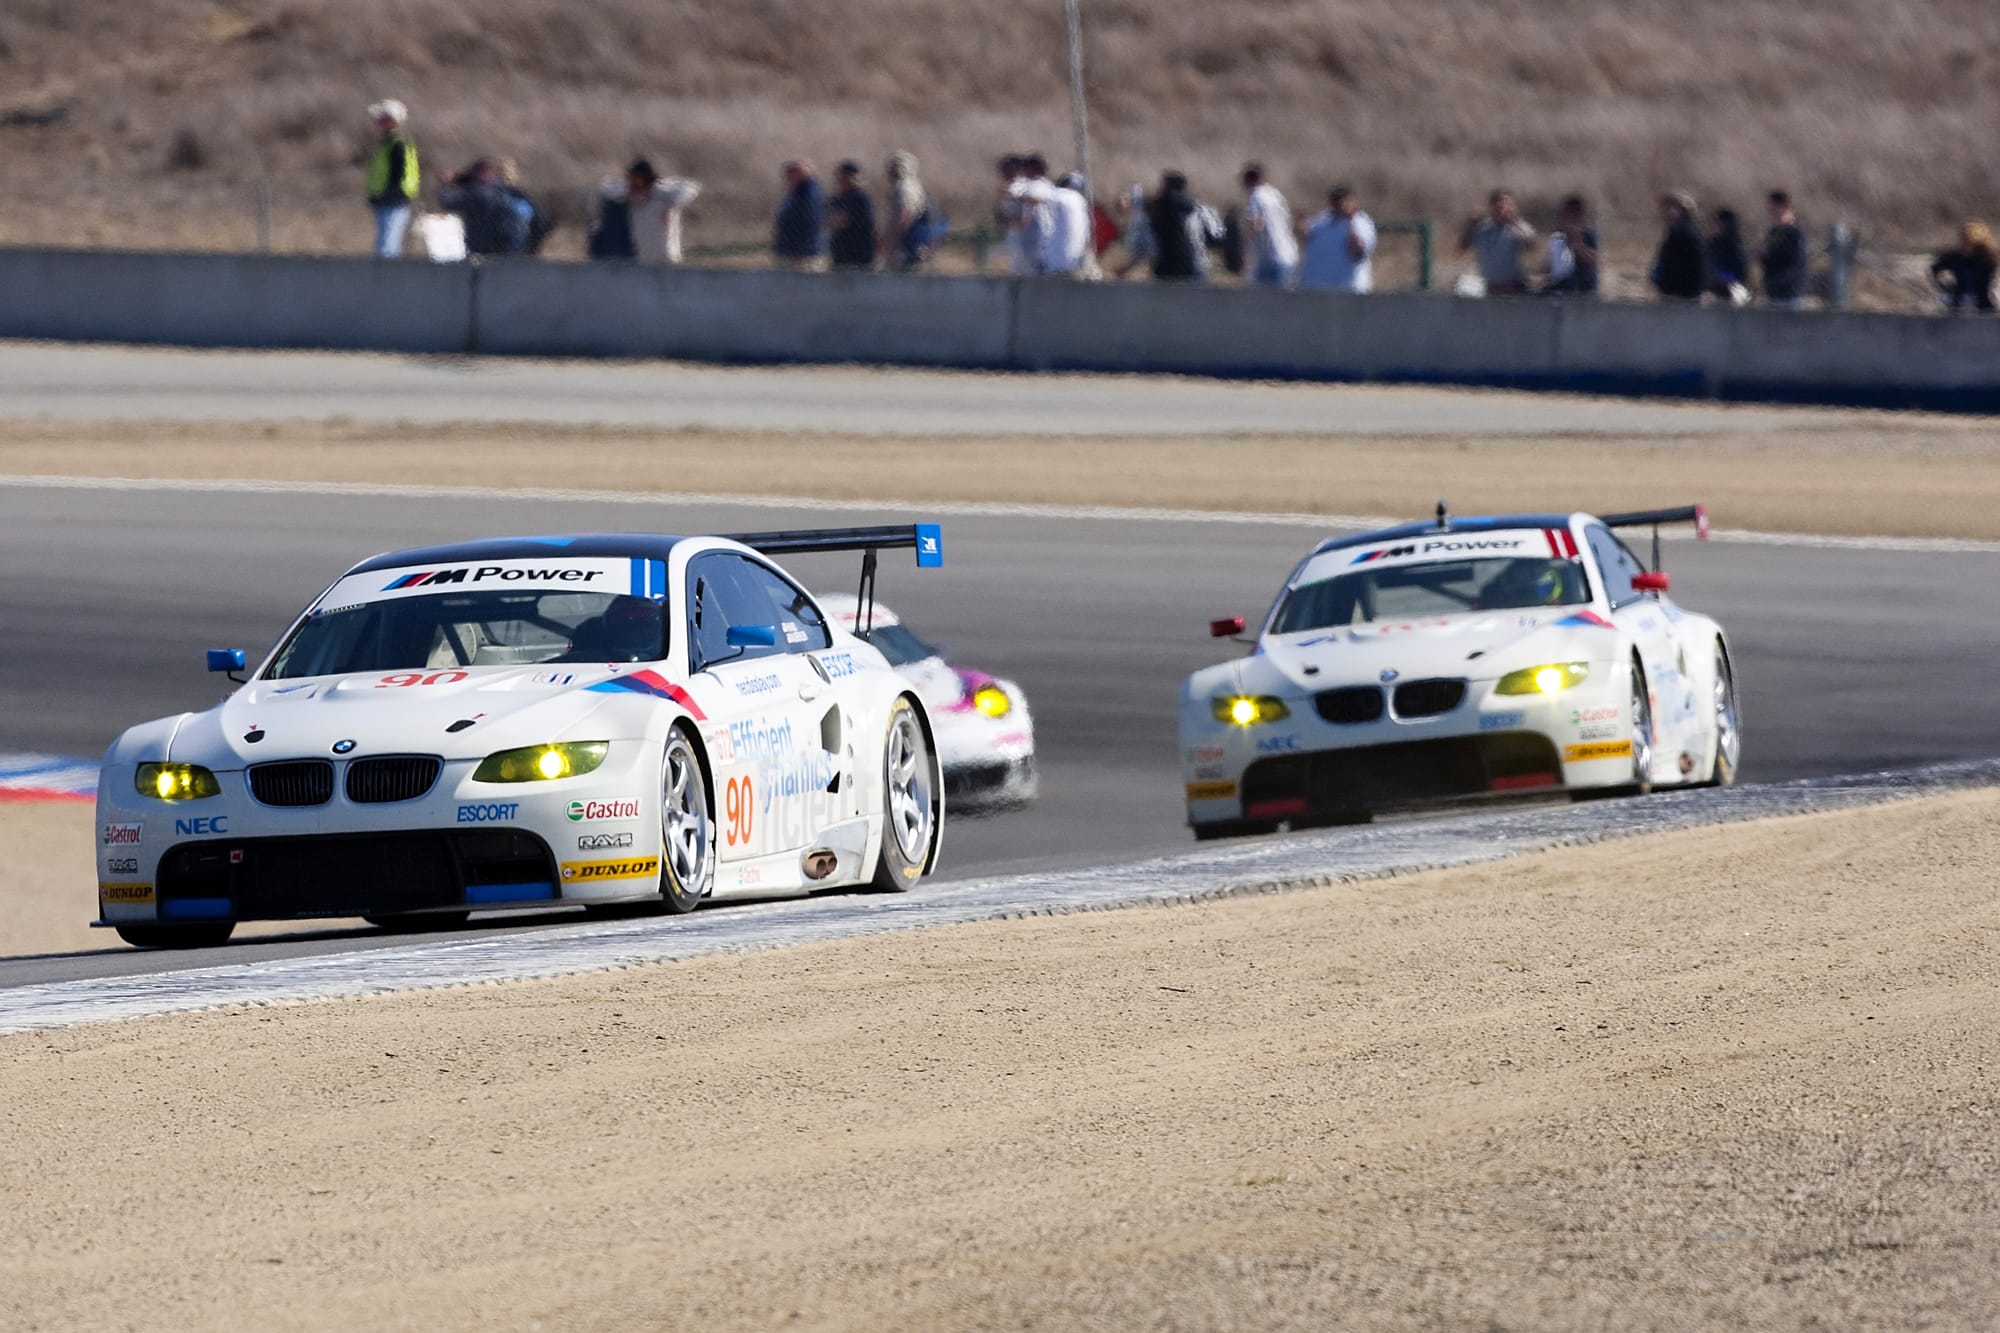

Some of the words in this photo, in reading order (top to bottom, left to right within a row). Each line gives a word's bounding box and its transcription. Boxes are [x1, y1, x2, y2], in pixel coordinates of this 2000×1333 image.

[1424, 538, 1525, 553] Power
[473, 567, 604, 582] Power
[374, 671, 469, 689] 90
[730, 717, 794, 761] Efficient
[456, 803, 519, 823] ESCORT
[585, 799, 639, 820] Castrol
[726, 775, 753, 847] 90
[110, 822, 142, 845] Castrol
[175, 815, 228, 836] NEC
[578, 832, 633, 849] RAYS
[579, 861, 657, 878] DUNLOP
[109, 885, 153, 899] DUNLOP
